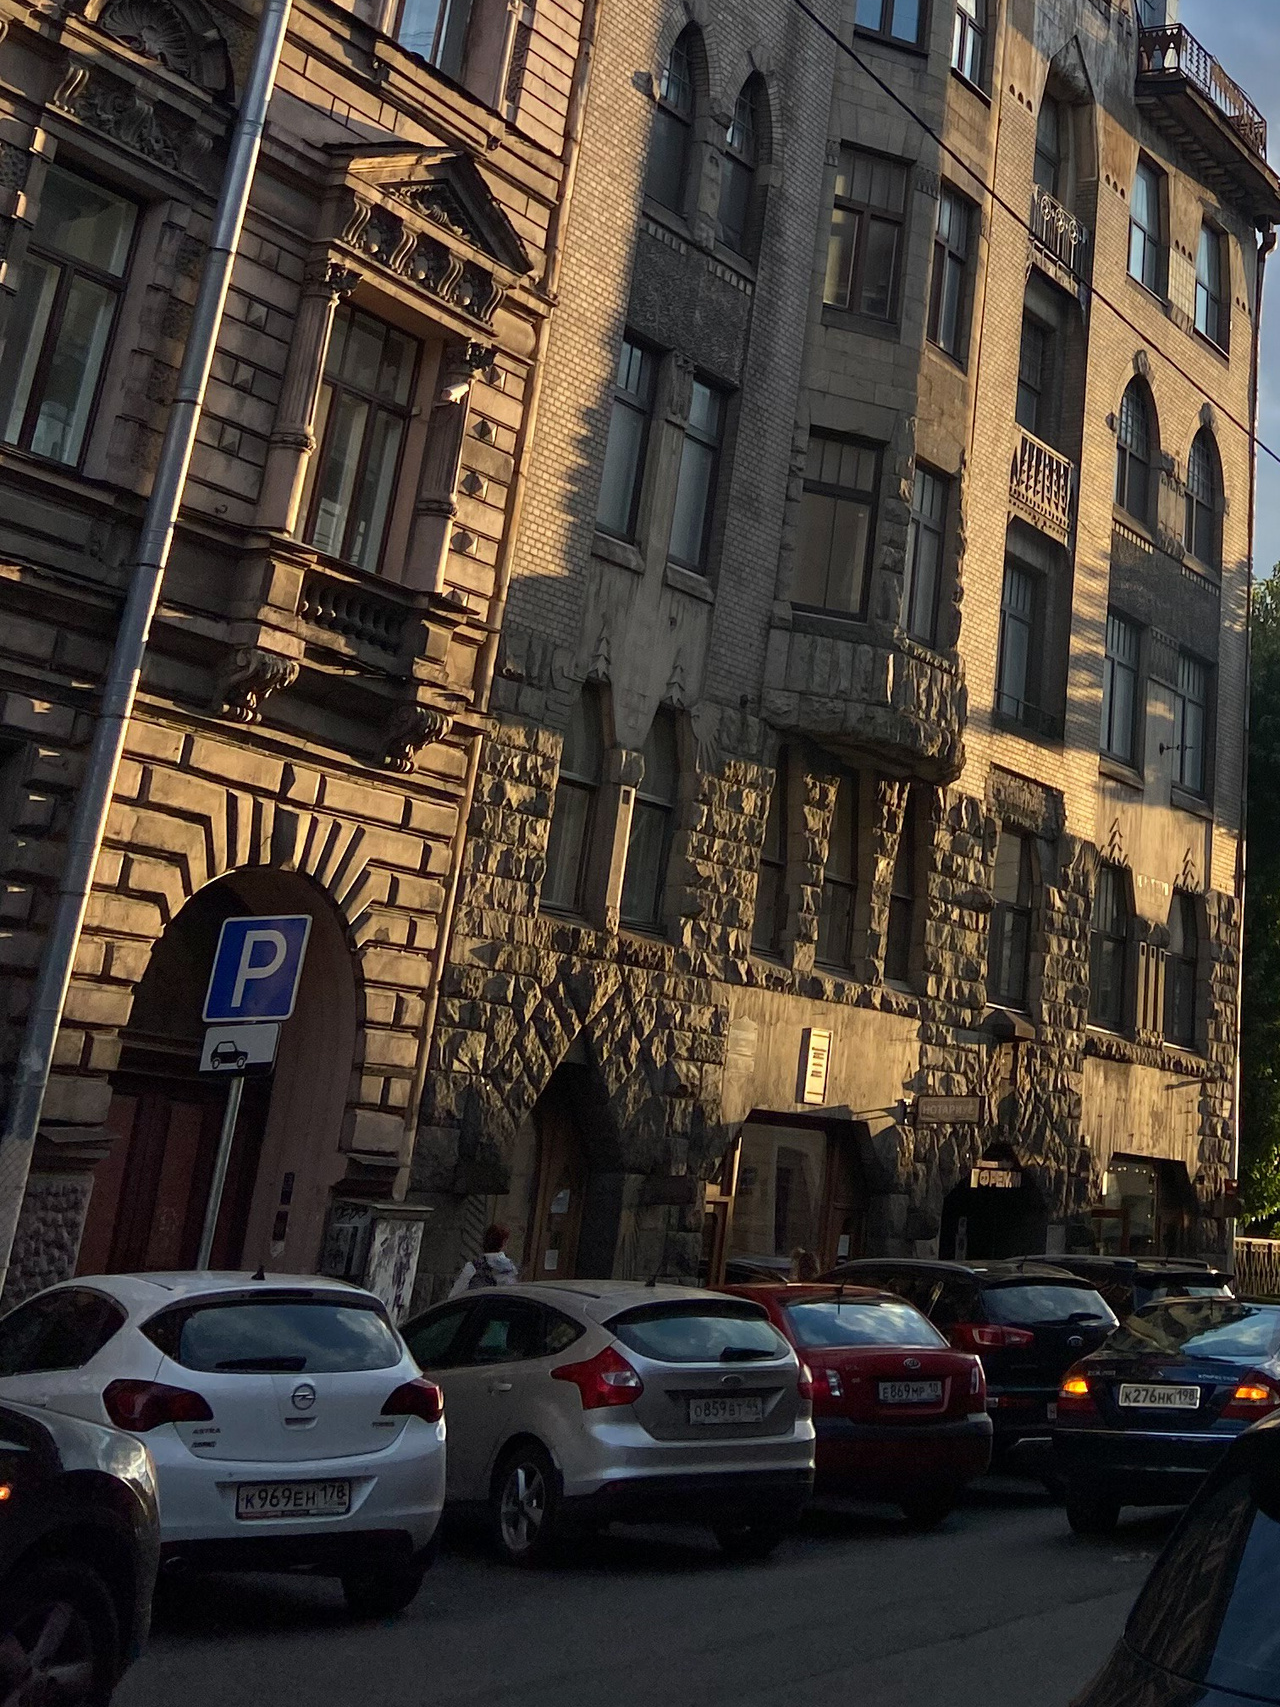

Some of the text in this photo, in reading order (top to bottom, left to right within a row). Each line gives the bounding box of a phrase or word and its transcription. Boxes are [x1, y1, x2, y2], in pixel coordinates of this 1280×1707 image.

[231, 929, 287, 1008] P
[922, 1104, 975, 1114] НОТАРИУС
[1124, 1389, 1173, 1404] К276НК
[245, 1488, 316, 1509] К969ЕН
